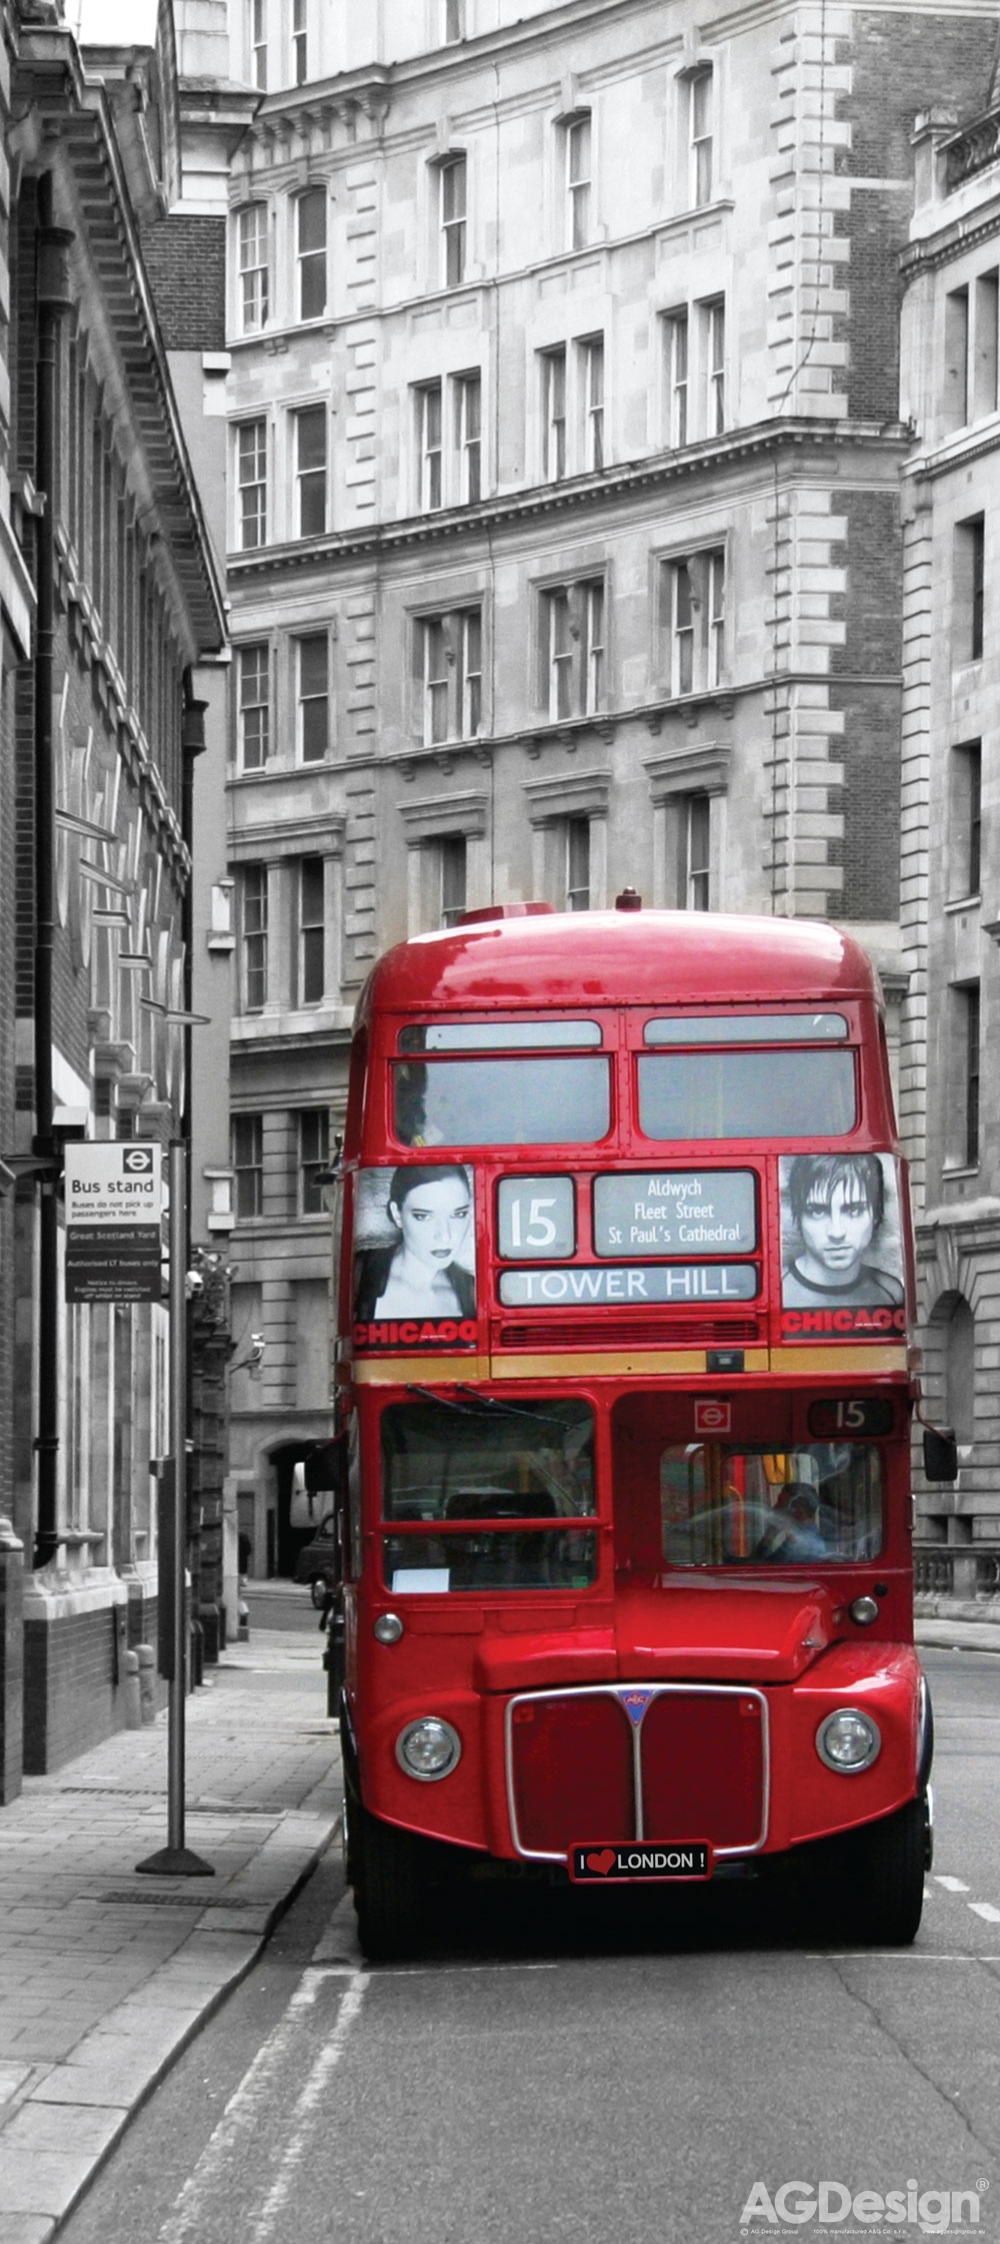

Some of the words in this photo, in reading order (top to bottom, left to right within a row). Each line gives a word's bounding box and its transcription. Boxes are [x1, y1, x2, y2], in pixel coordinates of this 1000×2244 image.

[72, 1179, 101, 1193] Bus
[107, 1179, 154, 1193] stand
[647, 1178, 702, 1201] Aldwych
[71, 1201, 95, 1209] Buses
[97, 1201, 107, 1209] do
[109, 1201, 123, 1209] not
[125, 1201, 141, 1209] pick
[71, 1210, 116, 1219] passengers
[634, 1202, 667, 1220] Fleet
[676, 1201, 714, 1219] Street
[511, 1198, 557, 1247] 15
[69, 1231, 95, 1241] Great
[96, 1231, 135, 1240] Scotland
[137, 1230, 156, 1239] Yard
[608, 1226, 622, 1244] St
[630, 1225, 671, 1243] Paul's
[678, 1223, 741, 1243] Cathedral
[142, 1259, 159, 1268] only
[518, 1270, 648, 1299] TOWER
[666, 1268, 740, 1296] HILL
[782, 1307, 906, 1333] CHICAGO
[353, 1321, 477, 1345] CHICAGO
[836, 1401, 866, 1428] 15
[580, 1854, 585, 1870] I
[617, 1853, 693, 1869] LONDON
